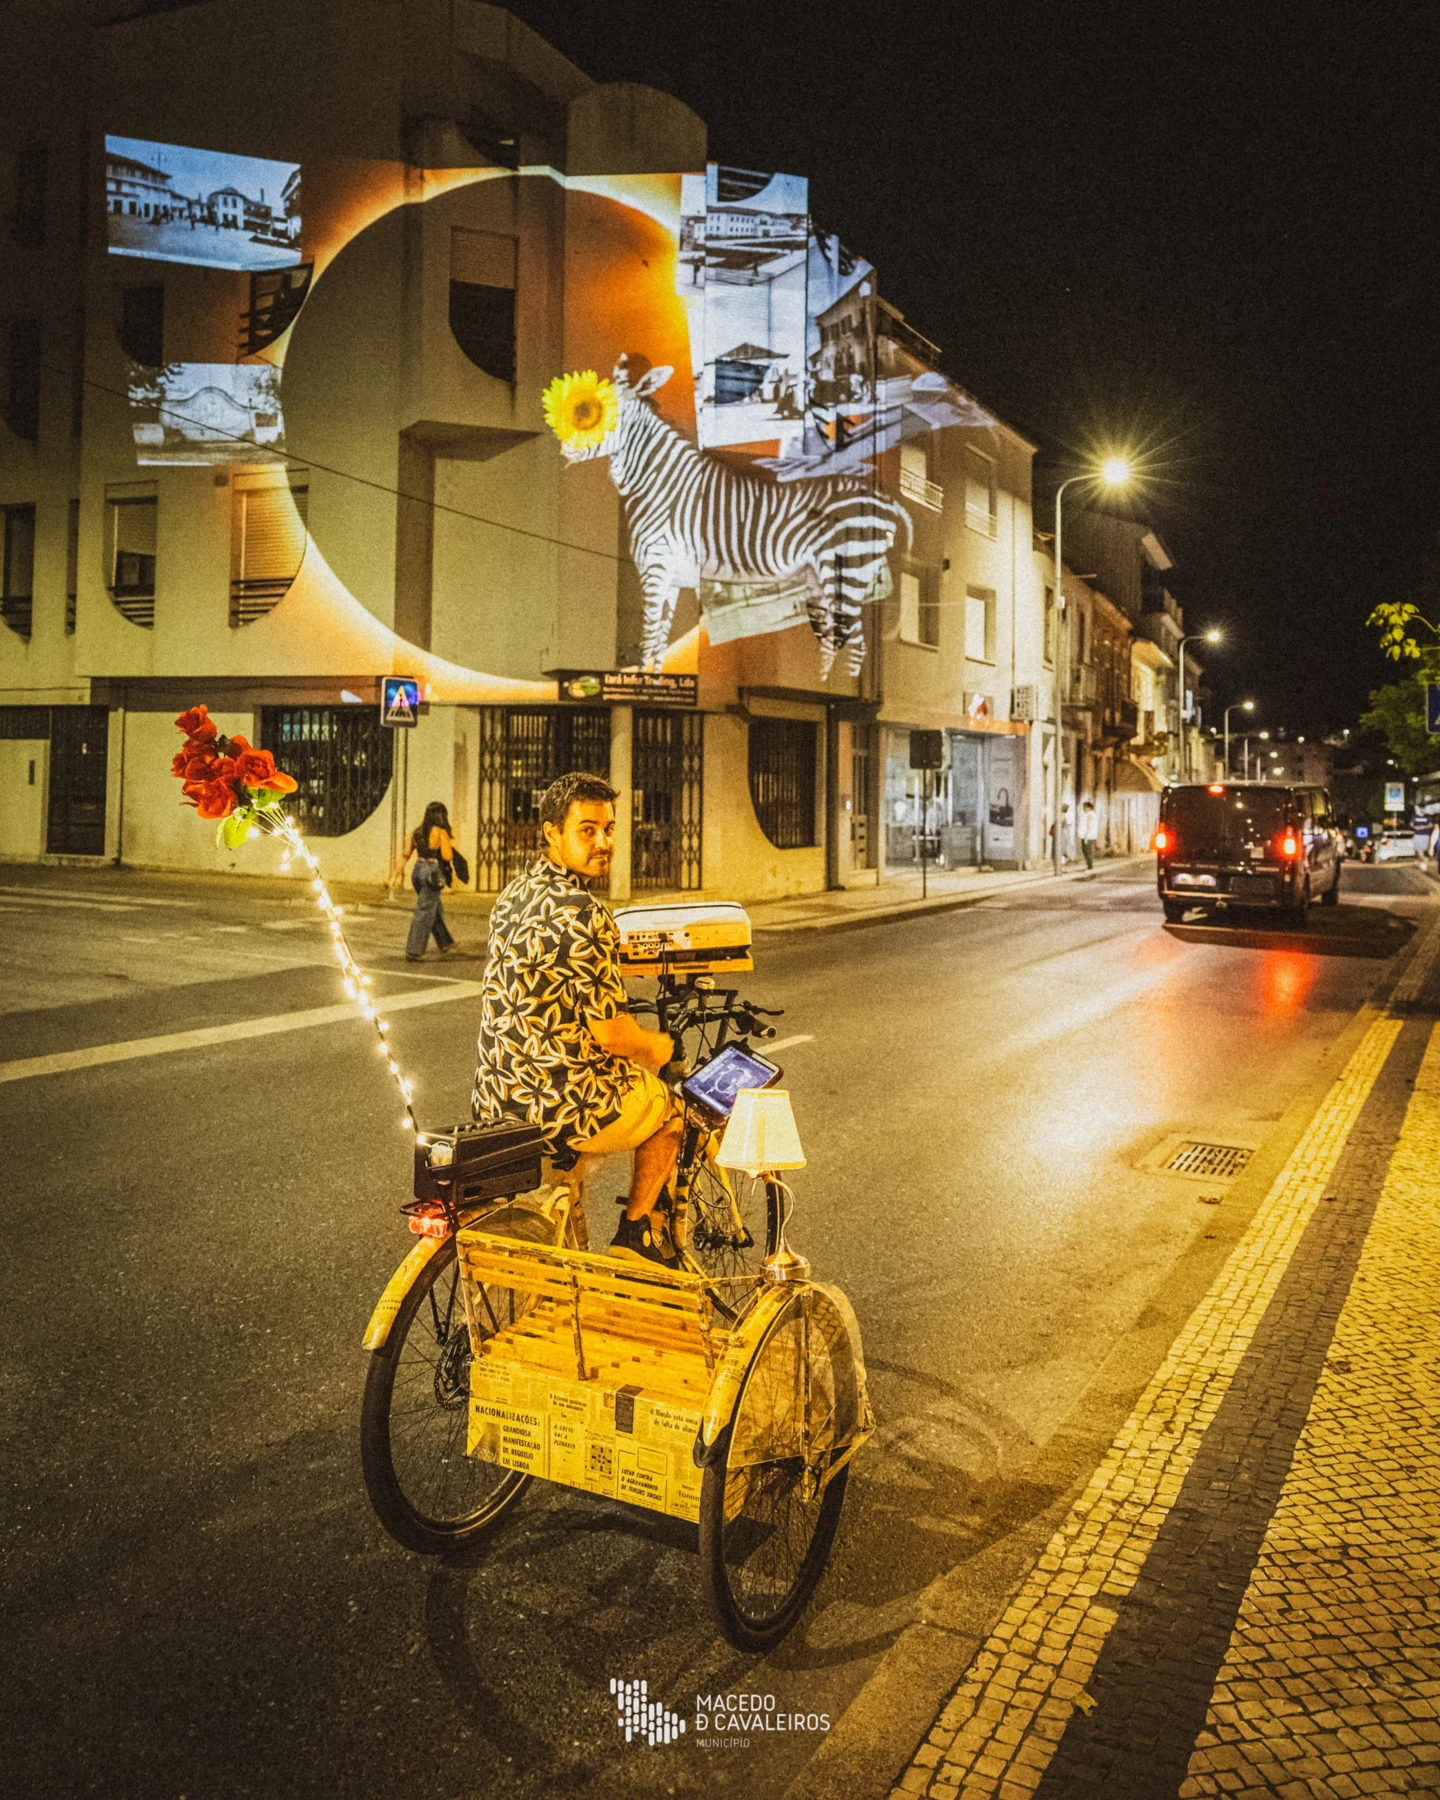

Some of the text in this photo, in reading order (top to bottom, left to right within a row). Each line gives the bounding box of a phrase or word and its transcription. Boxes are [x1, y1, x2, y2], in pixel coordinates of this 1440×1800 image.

[655, 1409, 671, 1418] Mundo
[654, 1418, 660, 1426] de
[662, 1419, 672, 1428] falta
[503, 1425, 532, 1438] GRANDIOSA
[503, 1436, 541, 1450] MANIFESTAÇÃO
[503, 1446, 534, 1460] DE REGOZIJO
[503, 1458, 530, 1470] EM LISBOA
[622, 1468, 652, 1482] LUTAR CONTRA
[627, 1478, 658, 1492] AGRAVAMENTO
